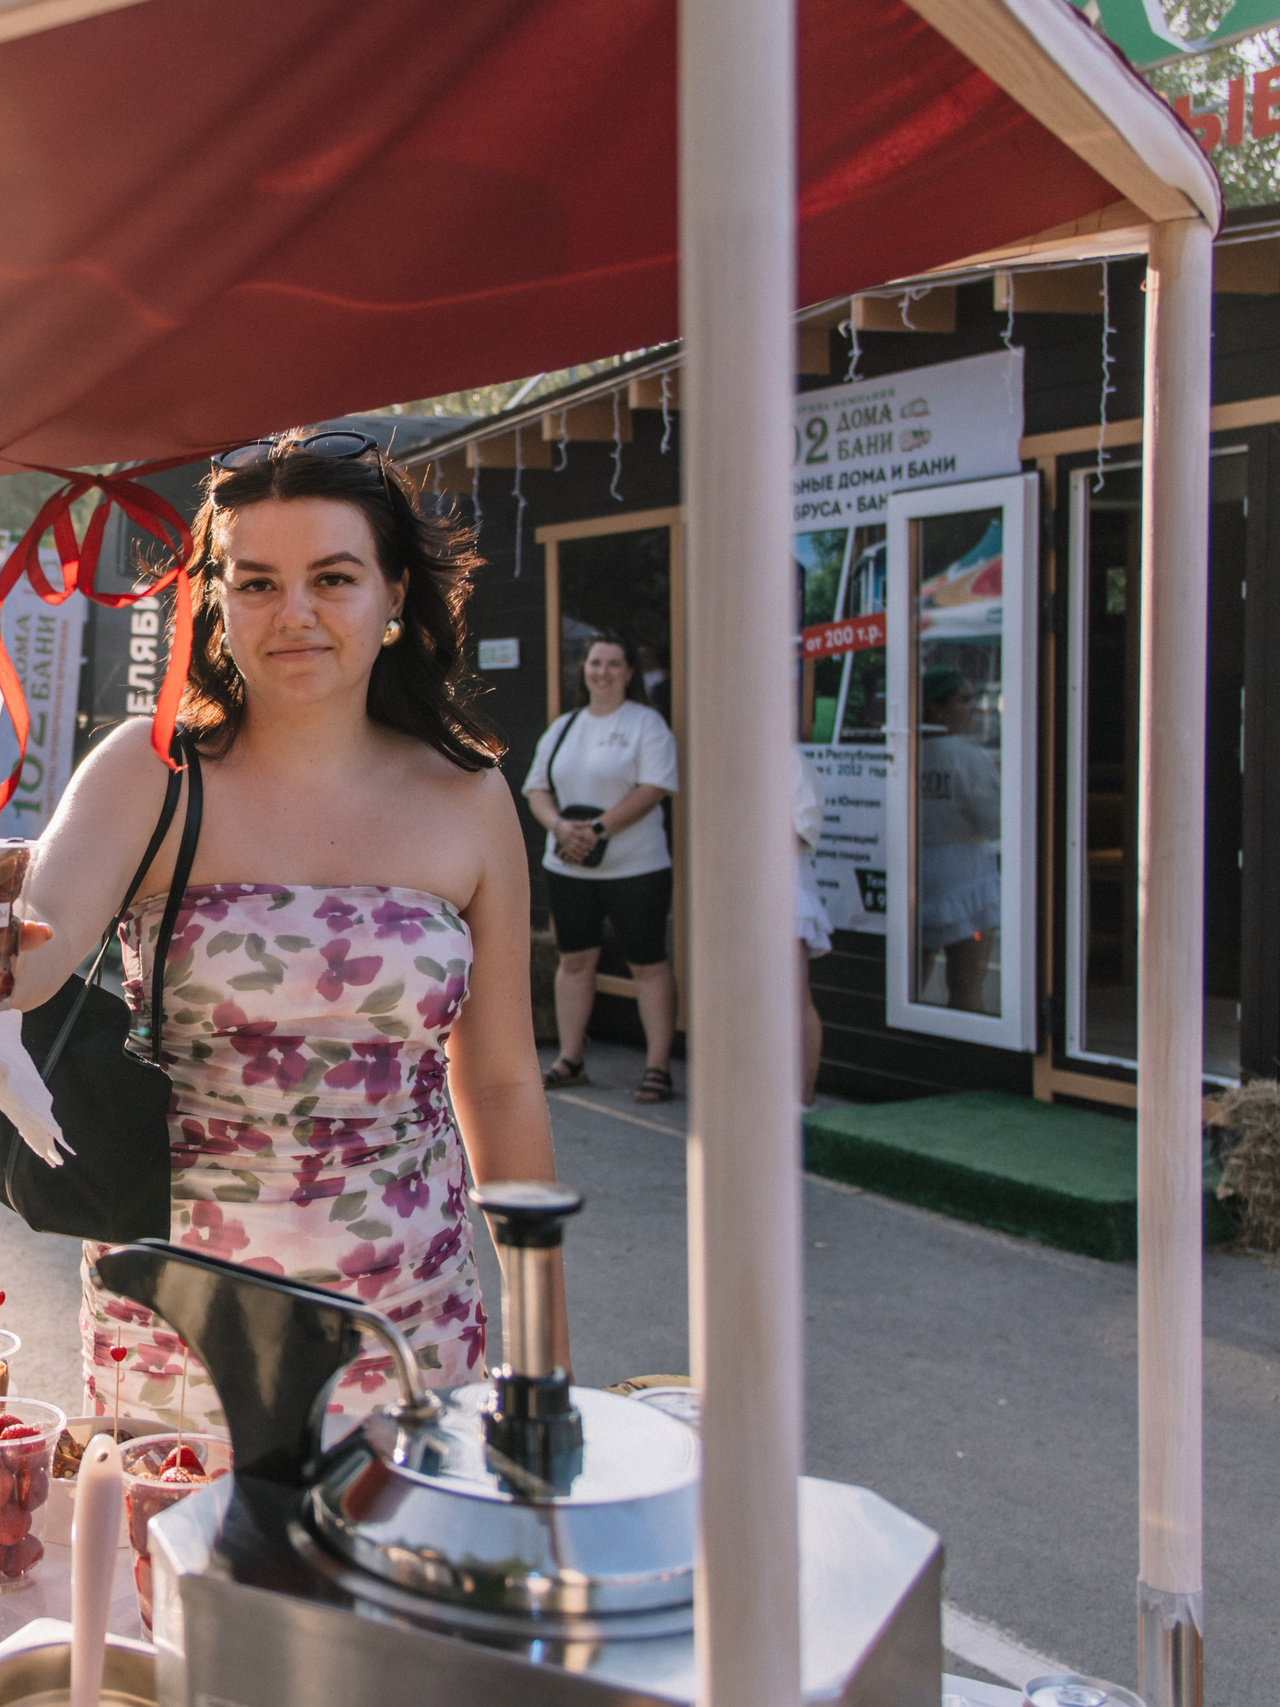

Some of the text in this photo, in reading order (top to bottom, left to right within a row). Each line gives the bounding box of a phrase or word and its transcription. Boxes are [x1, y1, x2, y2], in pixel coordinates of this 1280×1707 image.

[835, 403, 893, 432] ДОМА
[837, 432, 893, 461] БАНИ
[838, 469, 886, 490] ДОМА
[891, 464, 903, 480] И
[908, 456, 957, 479] БАНИ
[857, 494, 889, 513] БАН
[126, 584, 160, 713] ЕЛЯБИ
[824, 626, 854, 649] 200
[31, 614, 57, 700] БАНИ
[838, 764, 862, 777] 2012
